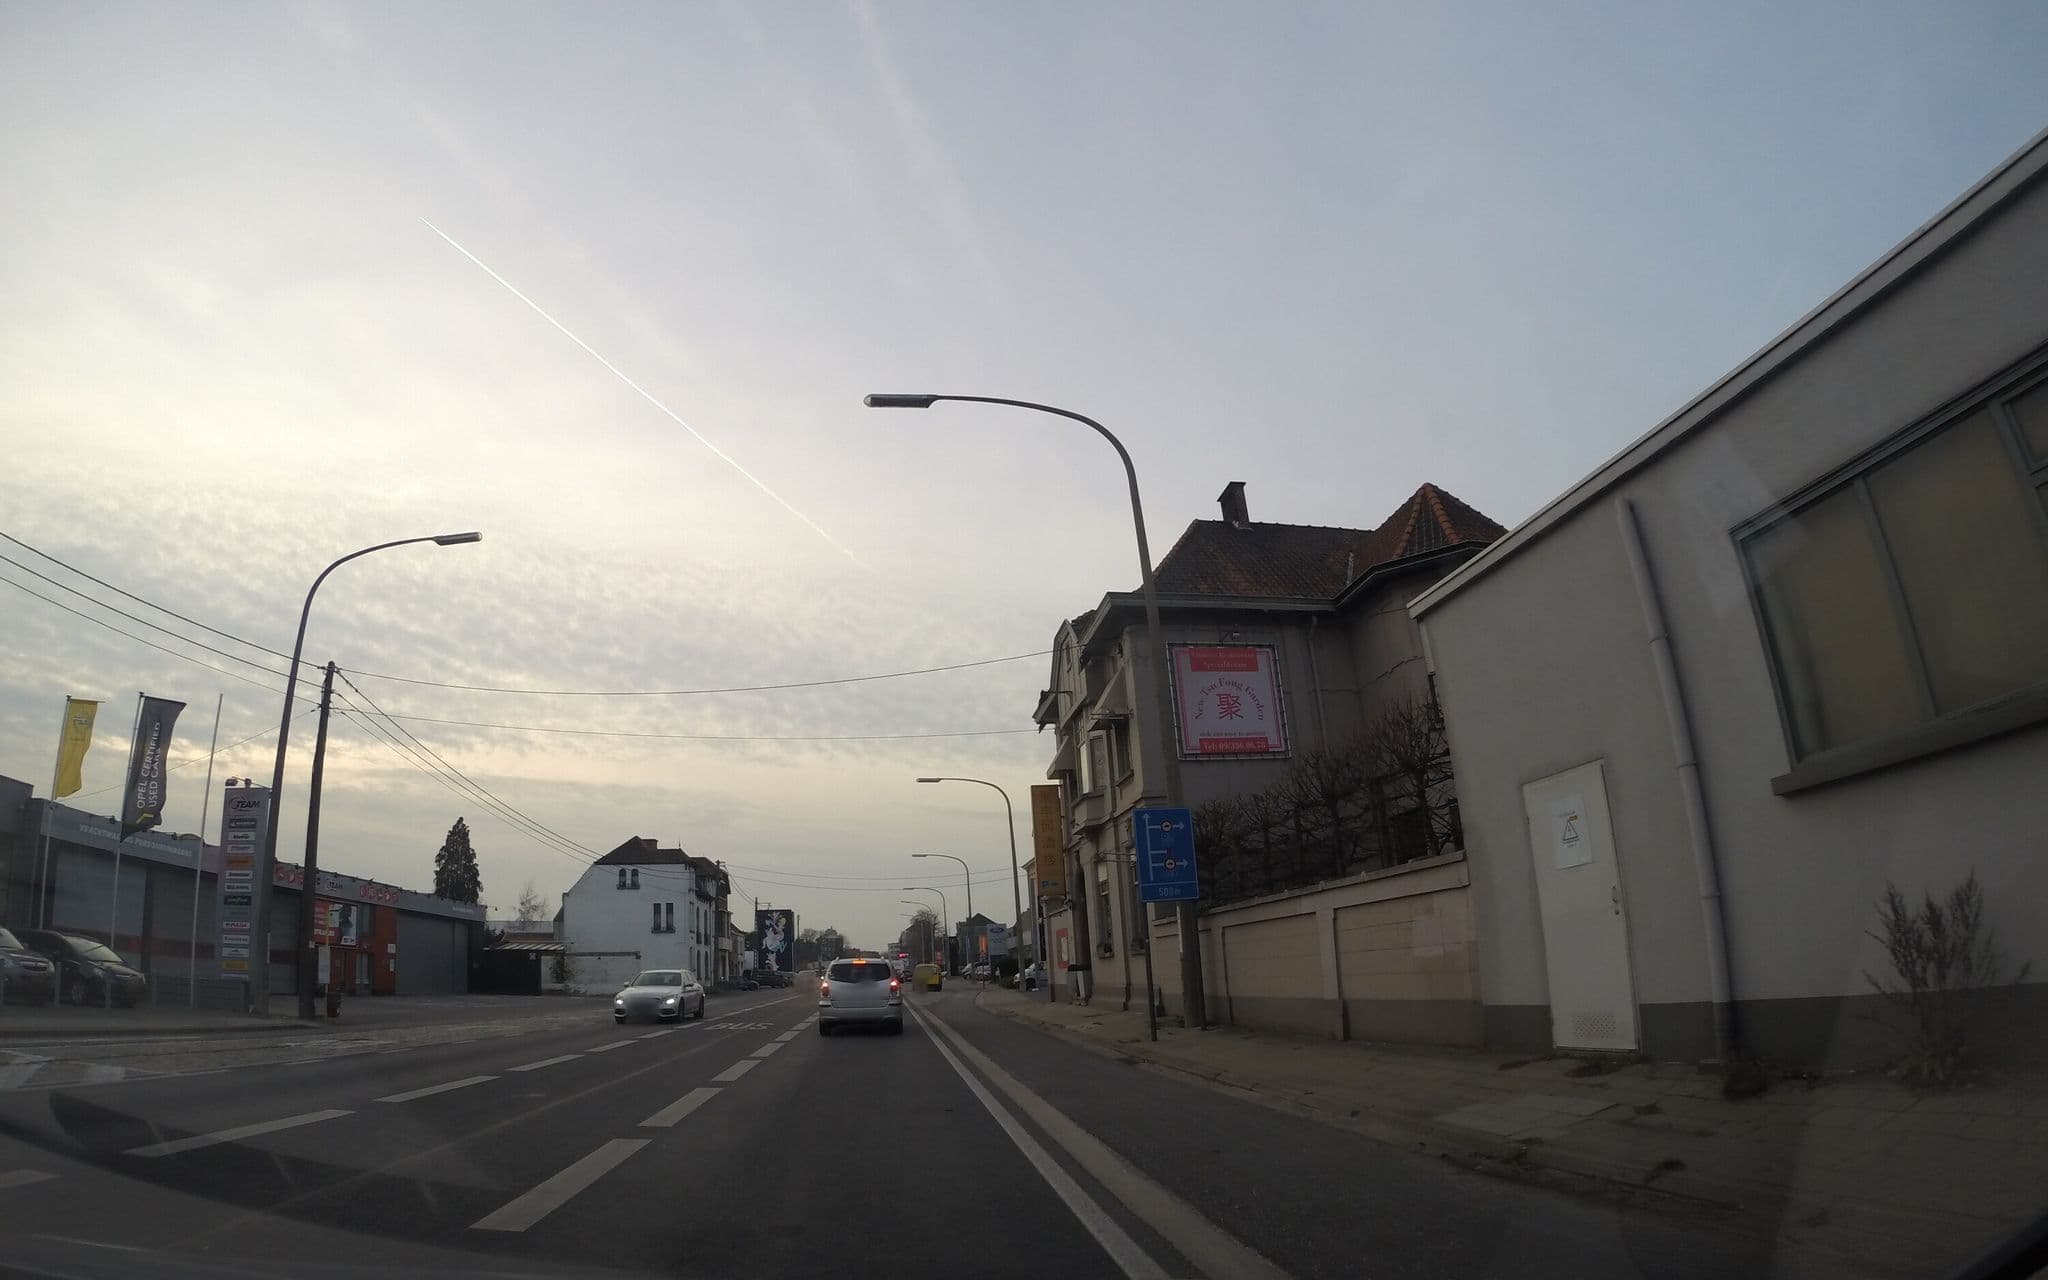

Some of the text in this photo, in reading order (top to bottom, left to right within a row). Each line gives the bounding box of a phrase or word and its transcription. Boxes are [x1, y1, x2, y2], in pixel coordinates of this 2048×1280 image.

[1192, 698, 1207, 720] New
[1218, 677, 1245, 691] Fong
[1245, 685, 1265, 721] Garden
[136, 722, 161, 809] OPEL CERTIFIED
[149, 781, 159, 808] USED
[704, 1022, 774, 1031] BUS
